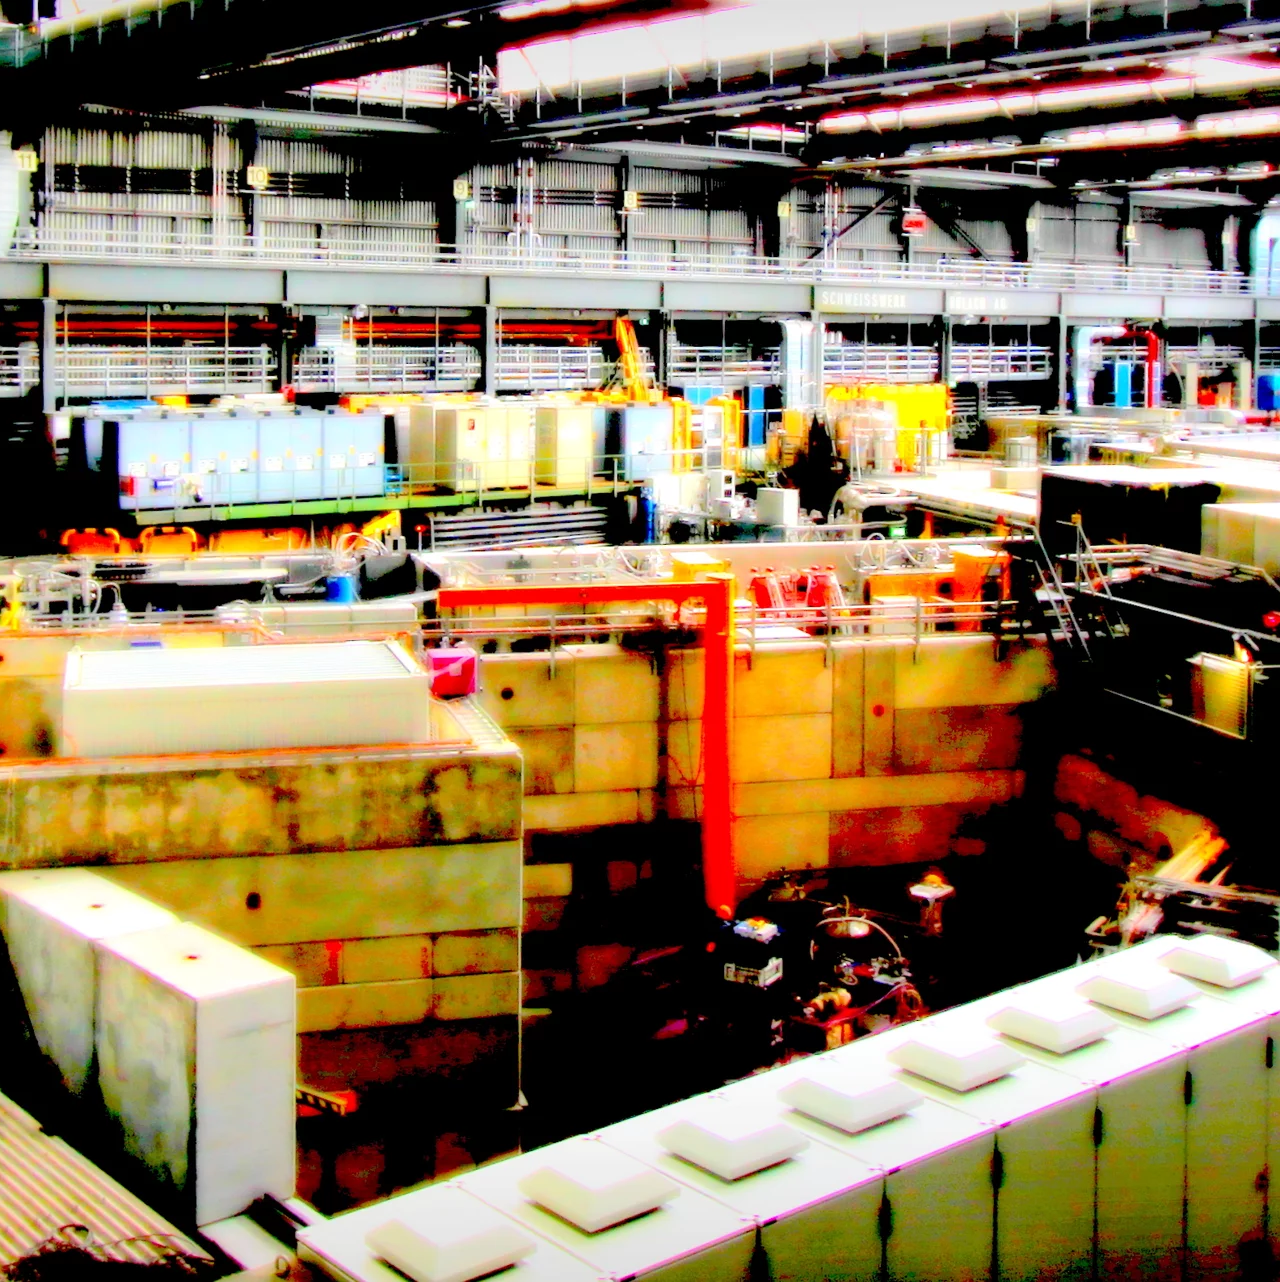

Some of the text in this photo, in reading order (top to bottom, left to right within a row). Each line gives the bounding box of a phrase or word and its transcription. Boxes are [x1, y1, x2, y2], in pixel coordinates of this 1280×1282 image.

[18, 152, 32, 169] 11
[249, 168, 266, 183] 10
[456, 181, 465, 195] 9
[626, 192, 634, 206] 8
[821, 291, 907, 308] SCHWEISSWERK
